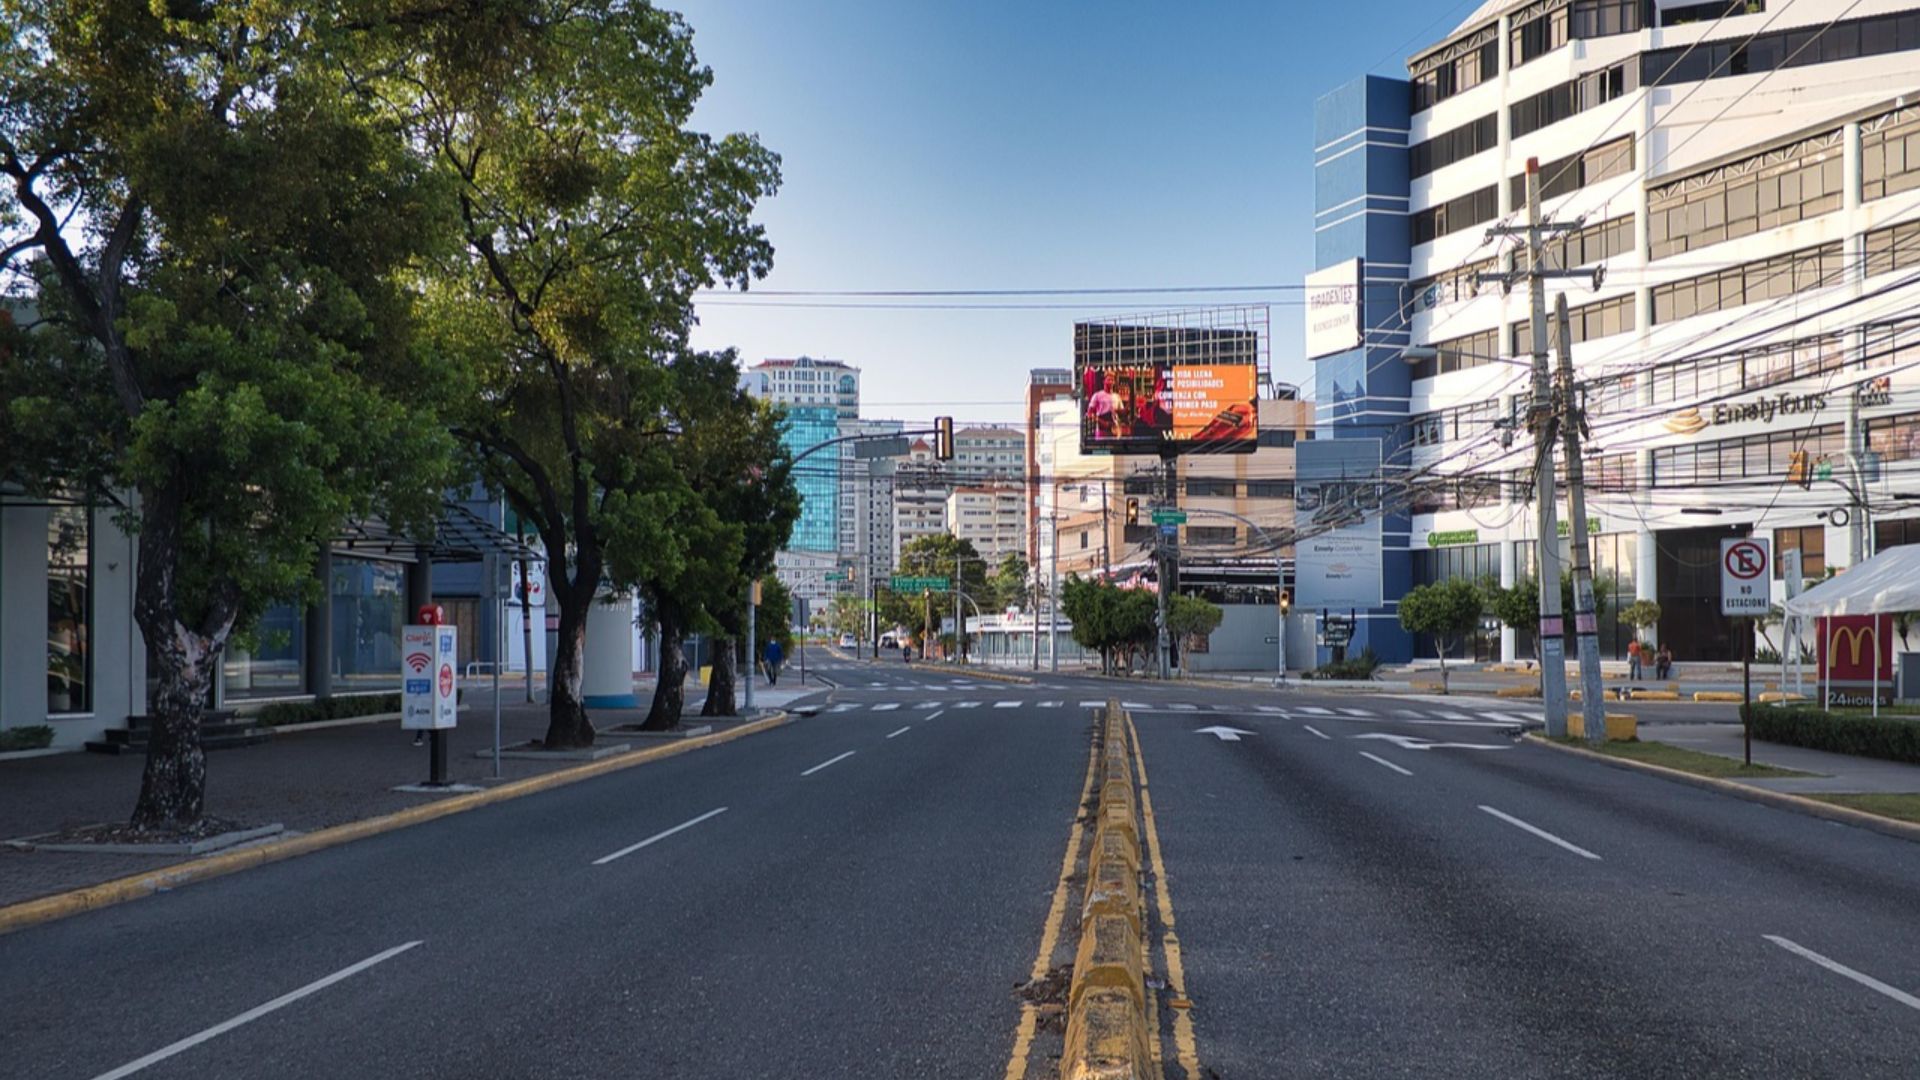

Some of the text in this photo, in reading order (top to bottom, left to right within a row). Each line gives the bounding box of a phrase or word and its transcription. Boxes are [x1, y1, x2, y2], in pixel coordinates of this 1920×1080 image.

[1177, 370, 1191, 378] VIDA
[1193, 370, 1213, 378] LLENA
[1174, 400, 1199, 409] PRIMER
[1201, 400, 1217, 408] PASO
[1740, 586, 1752, 594] NO
[1726, 598, 1766, 608] ESTACIONE
